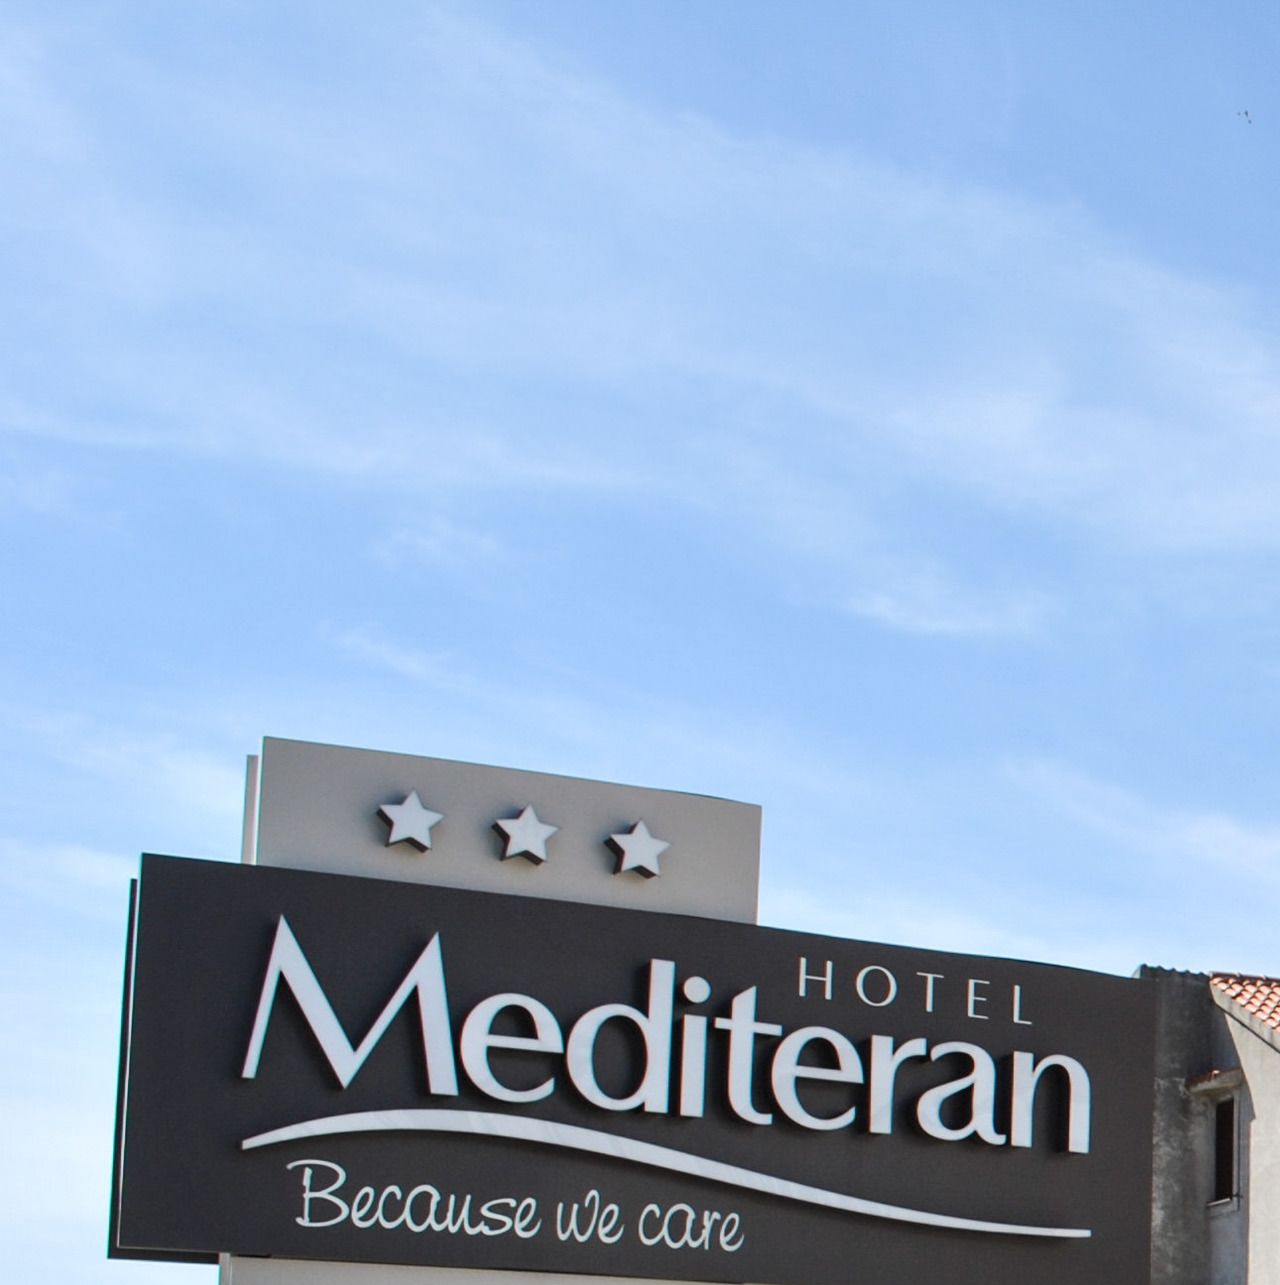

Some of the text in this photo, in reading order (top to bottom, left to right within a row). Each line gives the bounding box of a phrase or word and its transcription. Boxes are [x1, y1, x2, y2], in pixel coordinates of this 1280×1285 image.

[241, 914, 1091, 1154] Mediteran
[798, 957, 1033, 1025] HOTEL
[286, 1159, 744, 1253] Because we care
